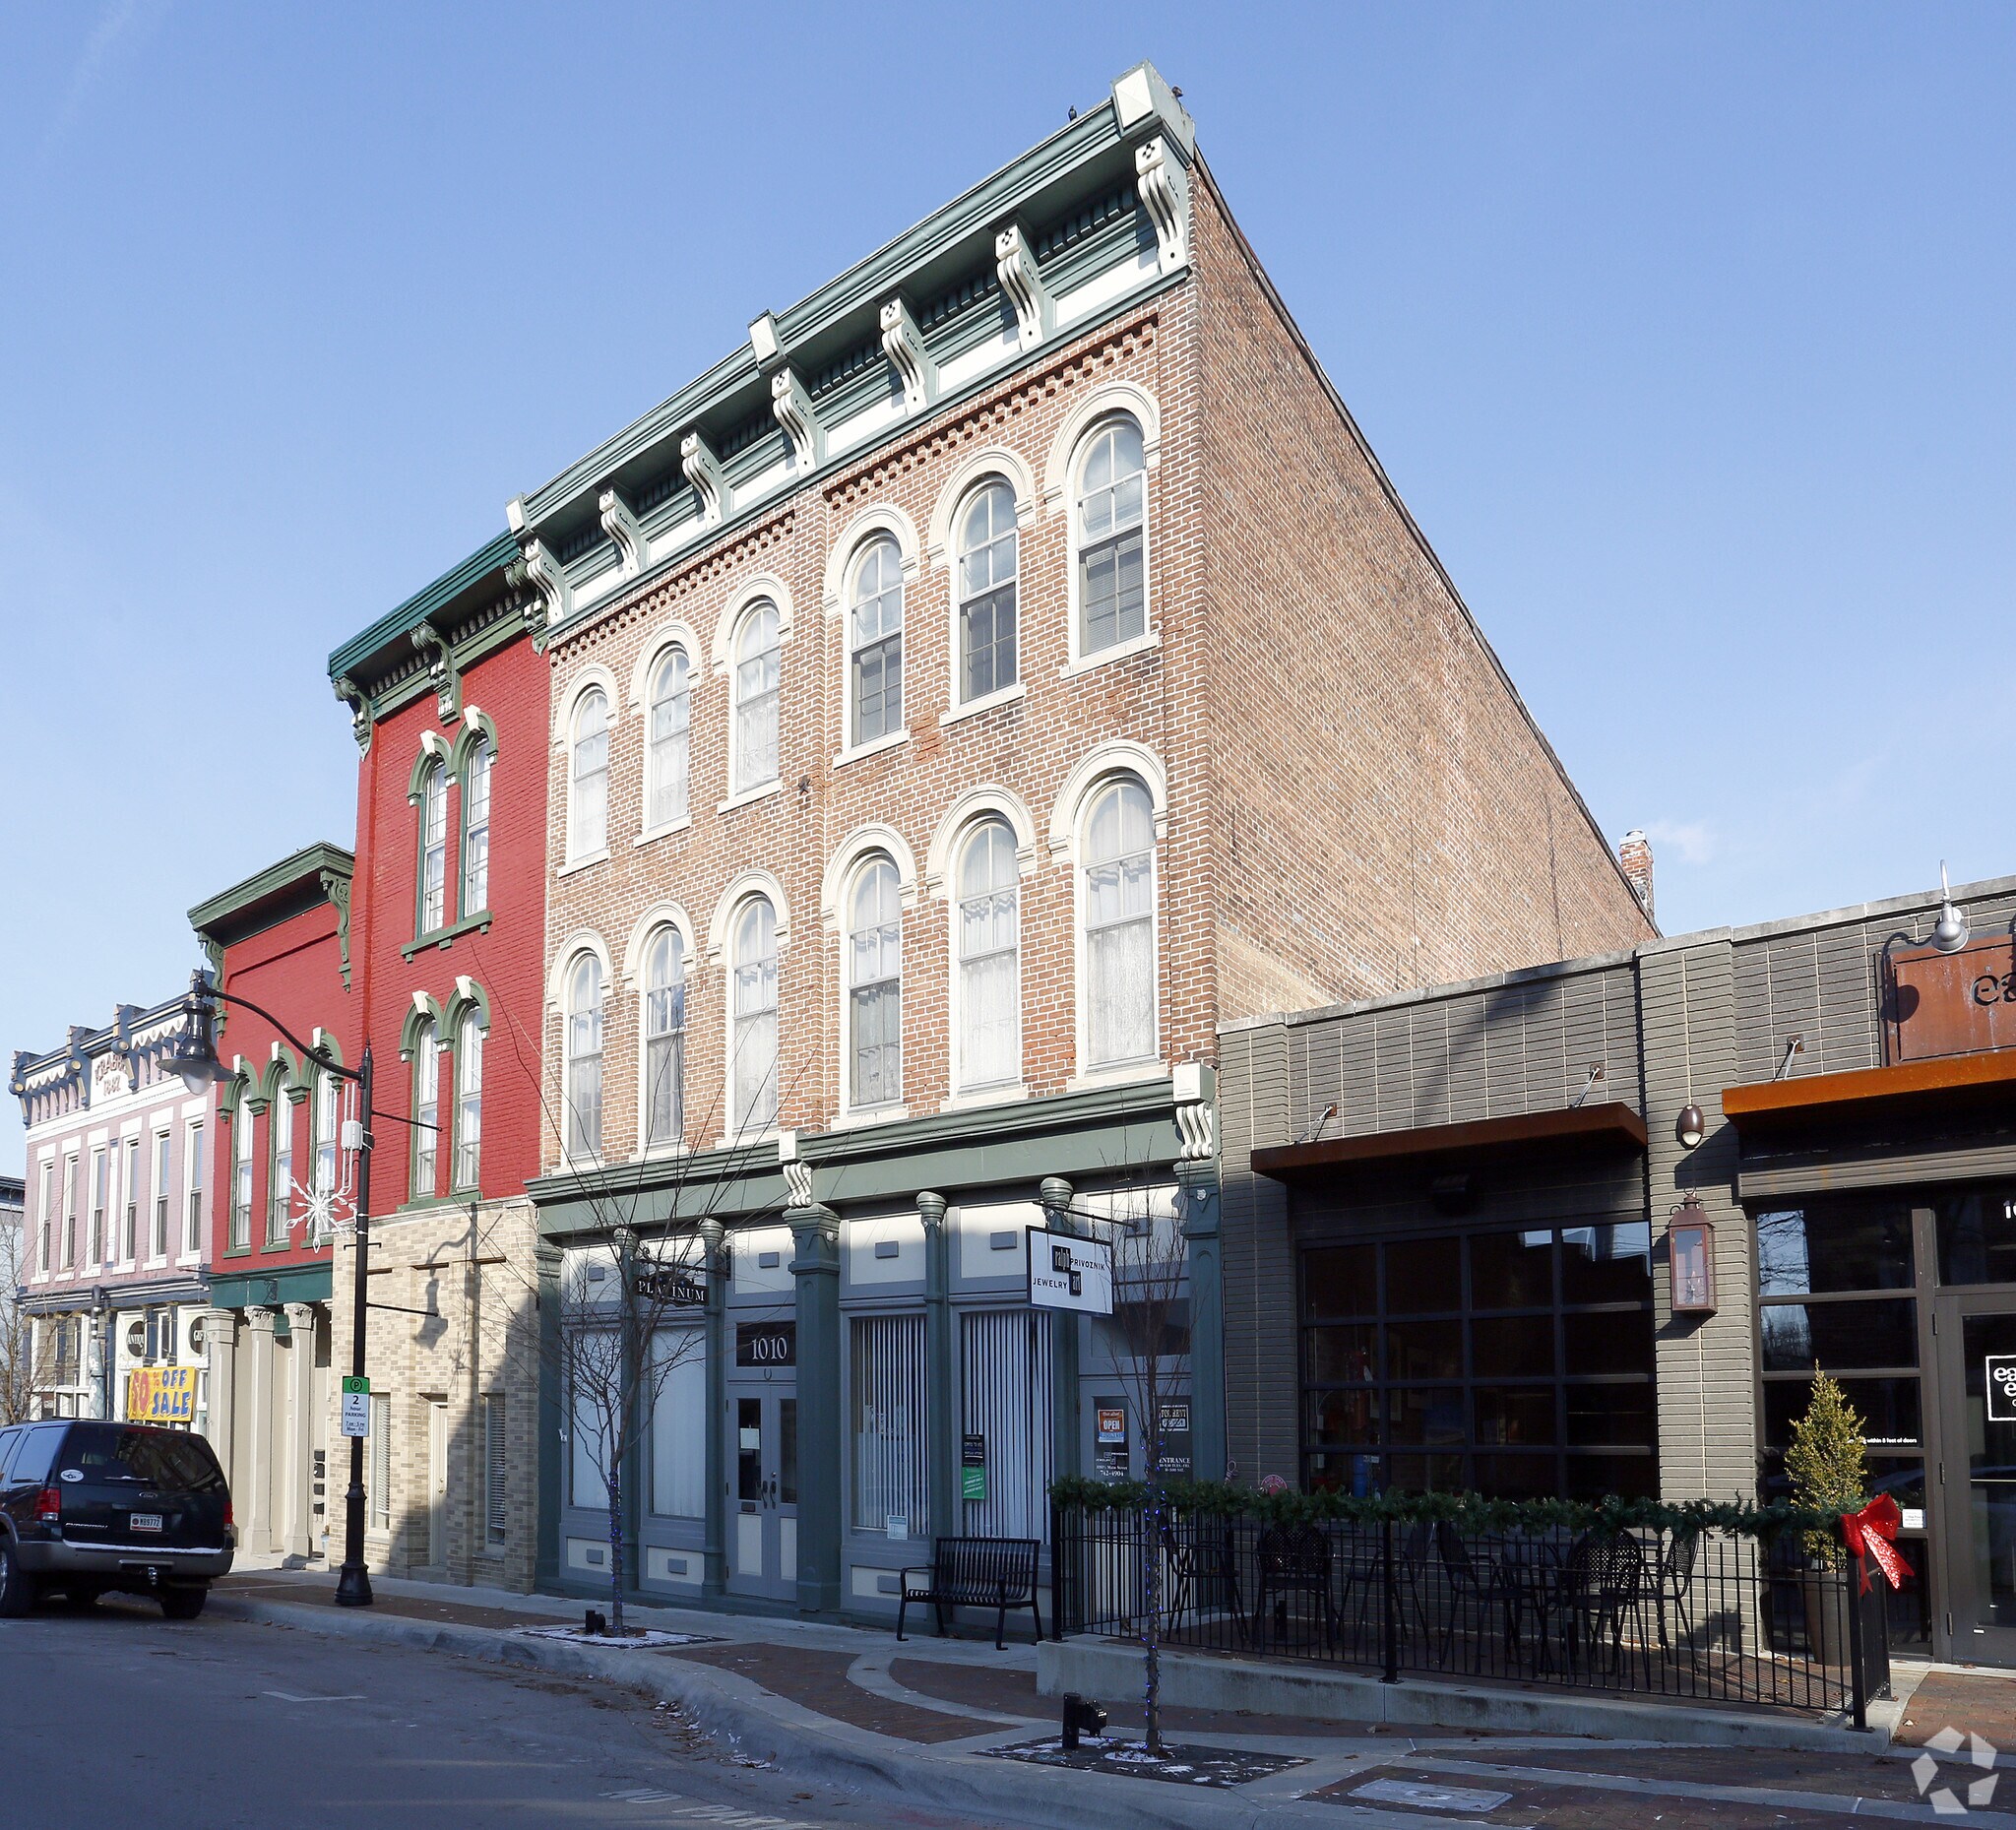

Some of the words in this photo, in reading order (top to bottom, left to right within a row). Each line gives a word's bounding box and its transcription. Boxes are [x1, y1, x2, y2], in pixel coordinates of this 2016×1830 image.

[1070, 1258, 1105, 1271] PRIVOZNIK
[638, 1280, 706, 1301] PLAINUM
[1033, 1278, 1068, 1290] JEWELRY
[751, 1337, 788, 1360] 1010
[161, 1369, 187, 1389] OFF
[151, 1391, 191, 1418] SALE
[352, 1395, 359, 1405] 2
[1103, 1420, 1120, 1430] OPEN
